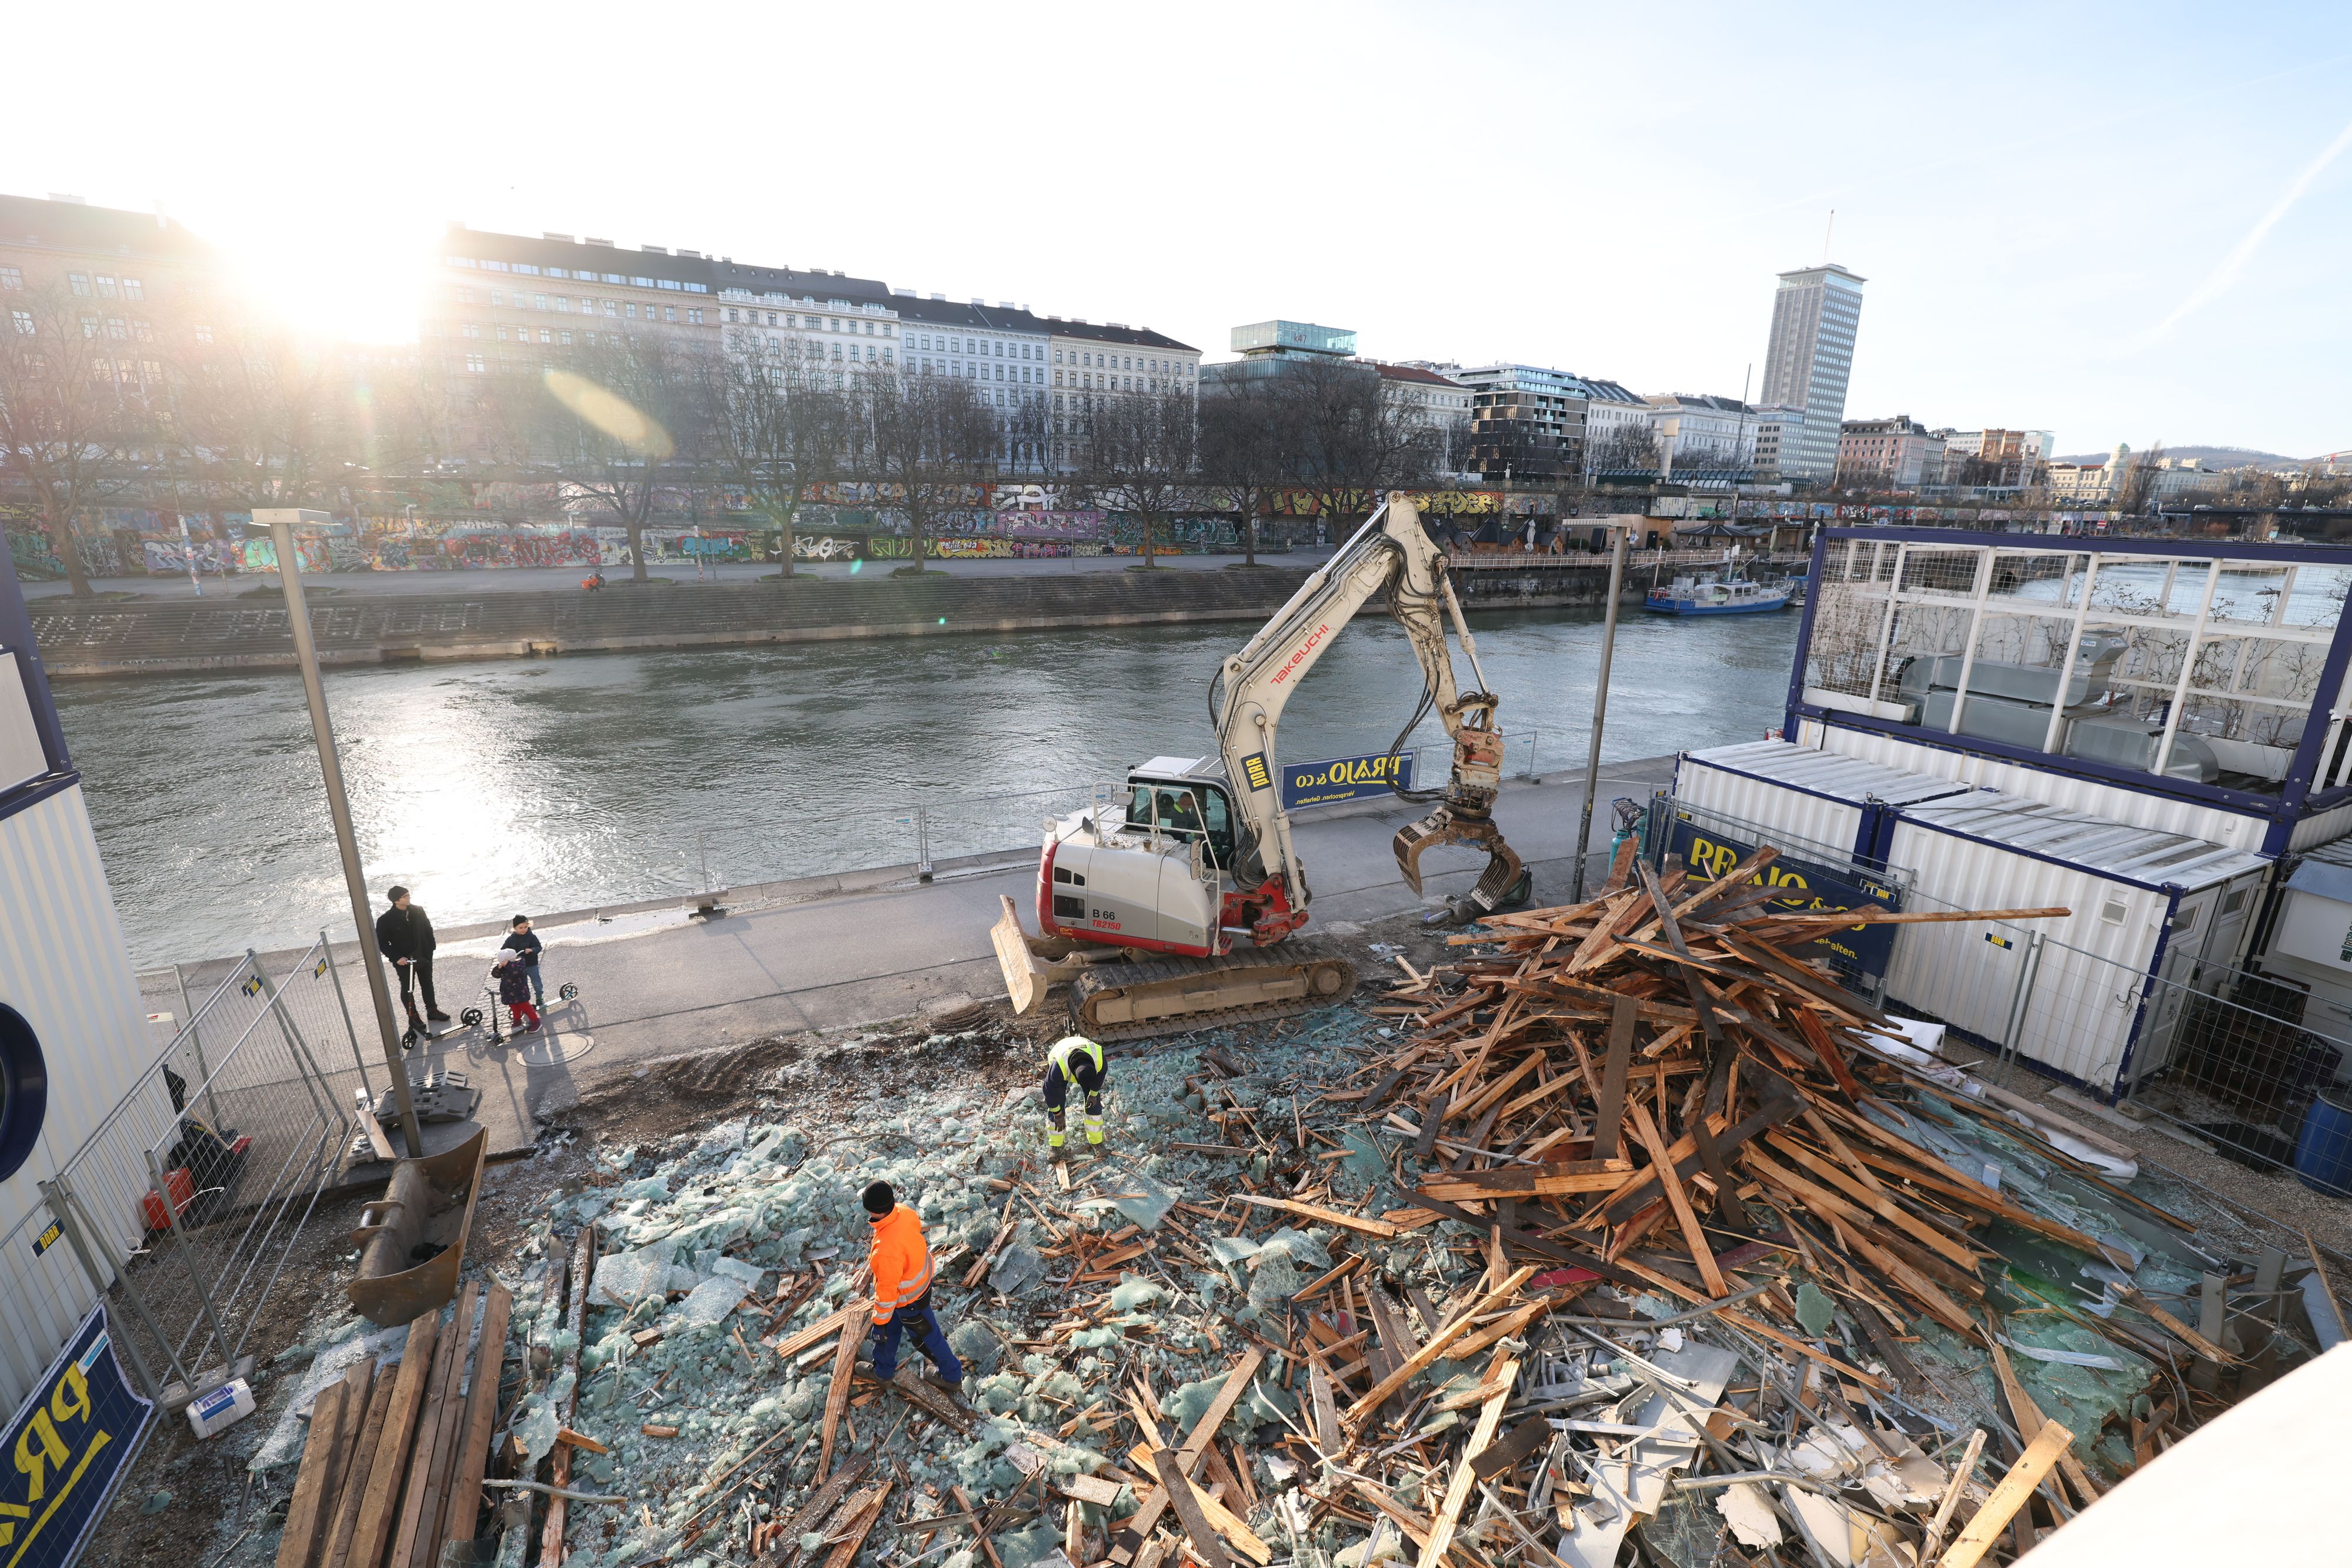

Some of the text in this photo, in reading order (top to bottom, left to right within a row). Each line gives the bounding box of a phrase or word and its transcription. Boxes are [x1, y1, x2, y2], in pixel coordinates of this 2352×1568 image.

[1294, 332, 1307, 343] k47
[1093, 909, 1115, 920] B 66
[1092, 920, 1121, 930] TB2150
